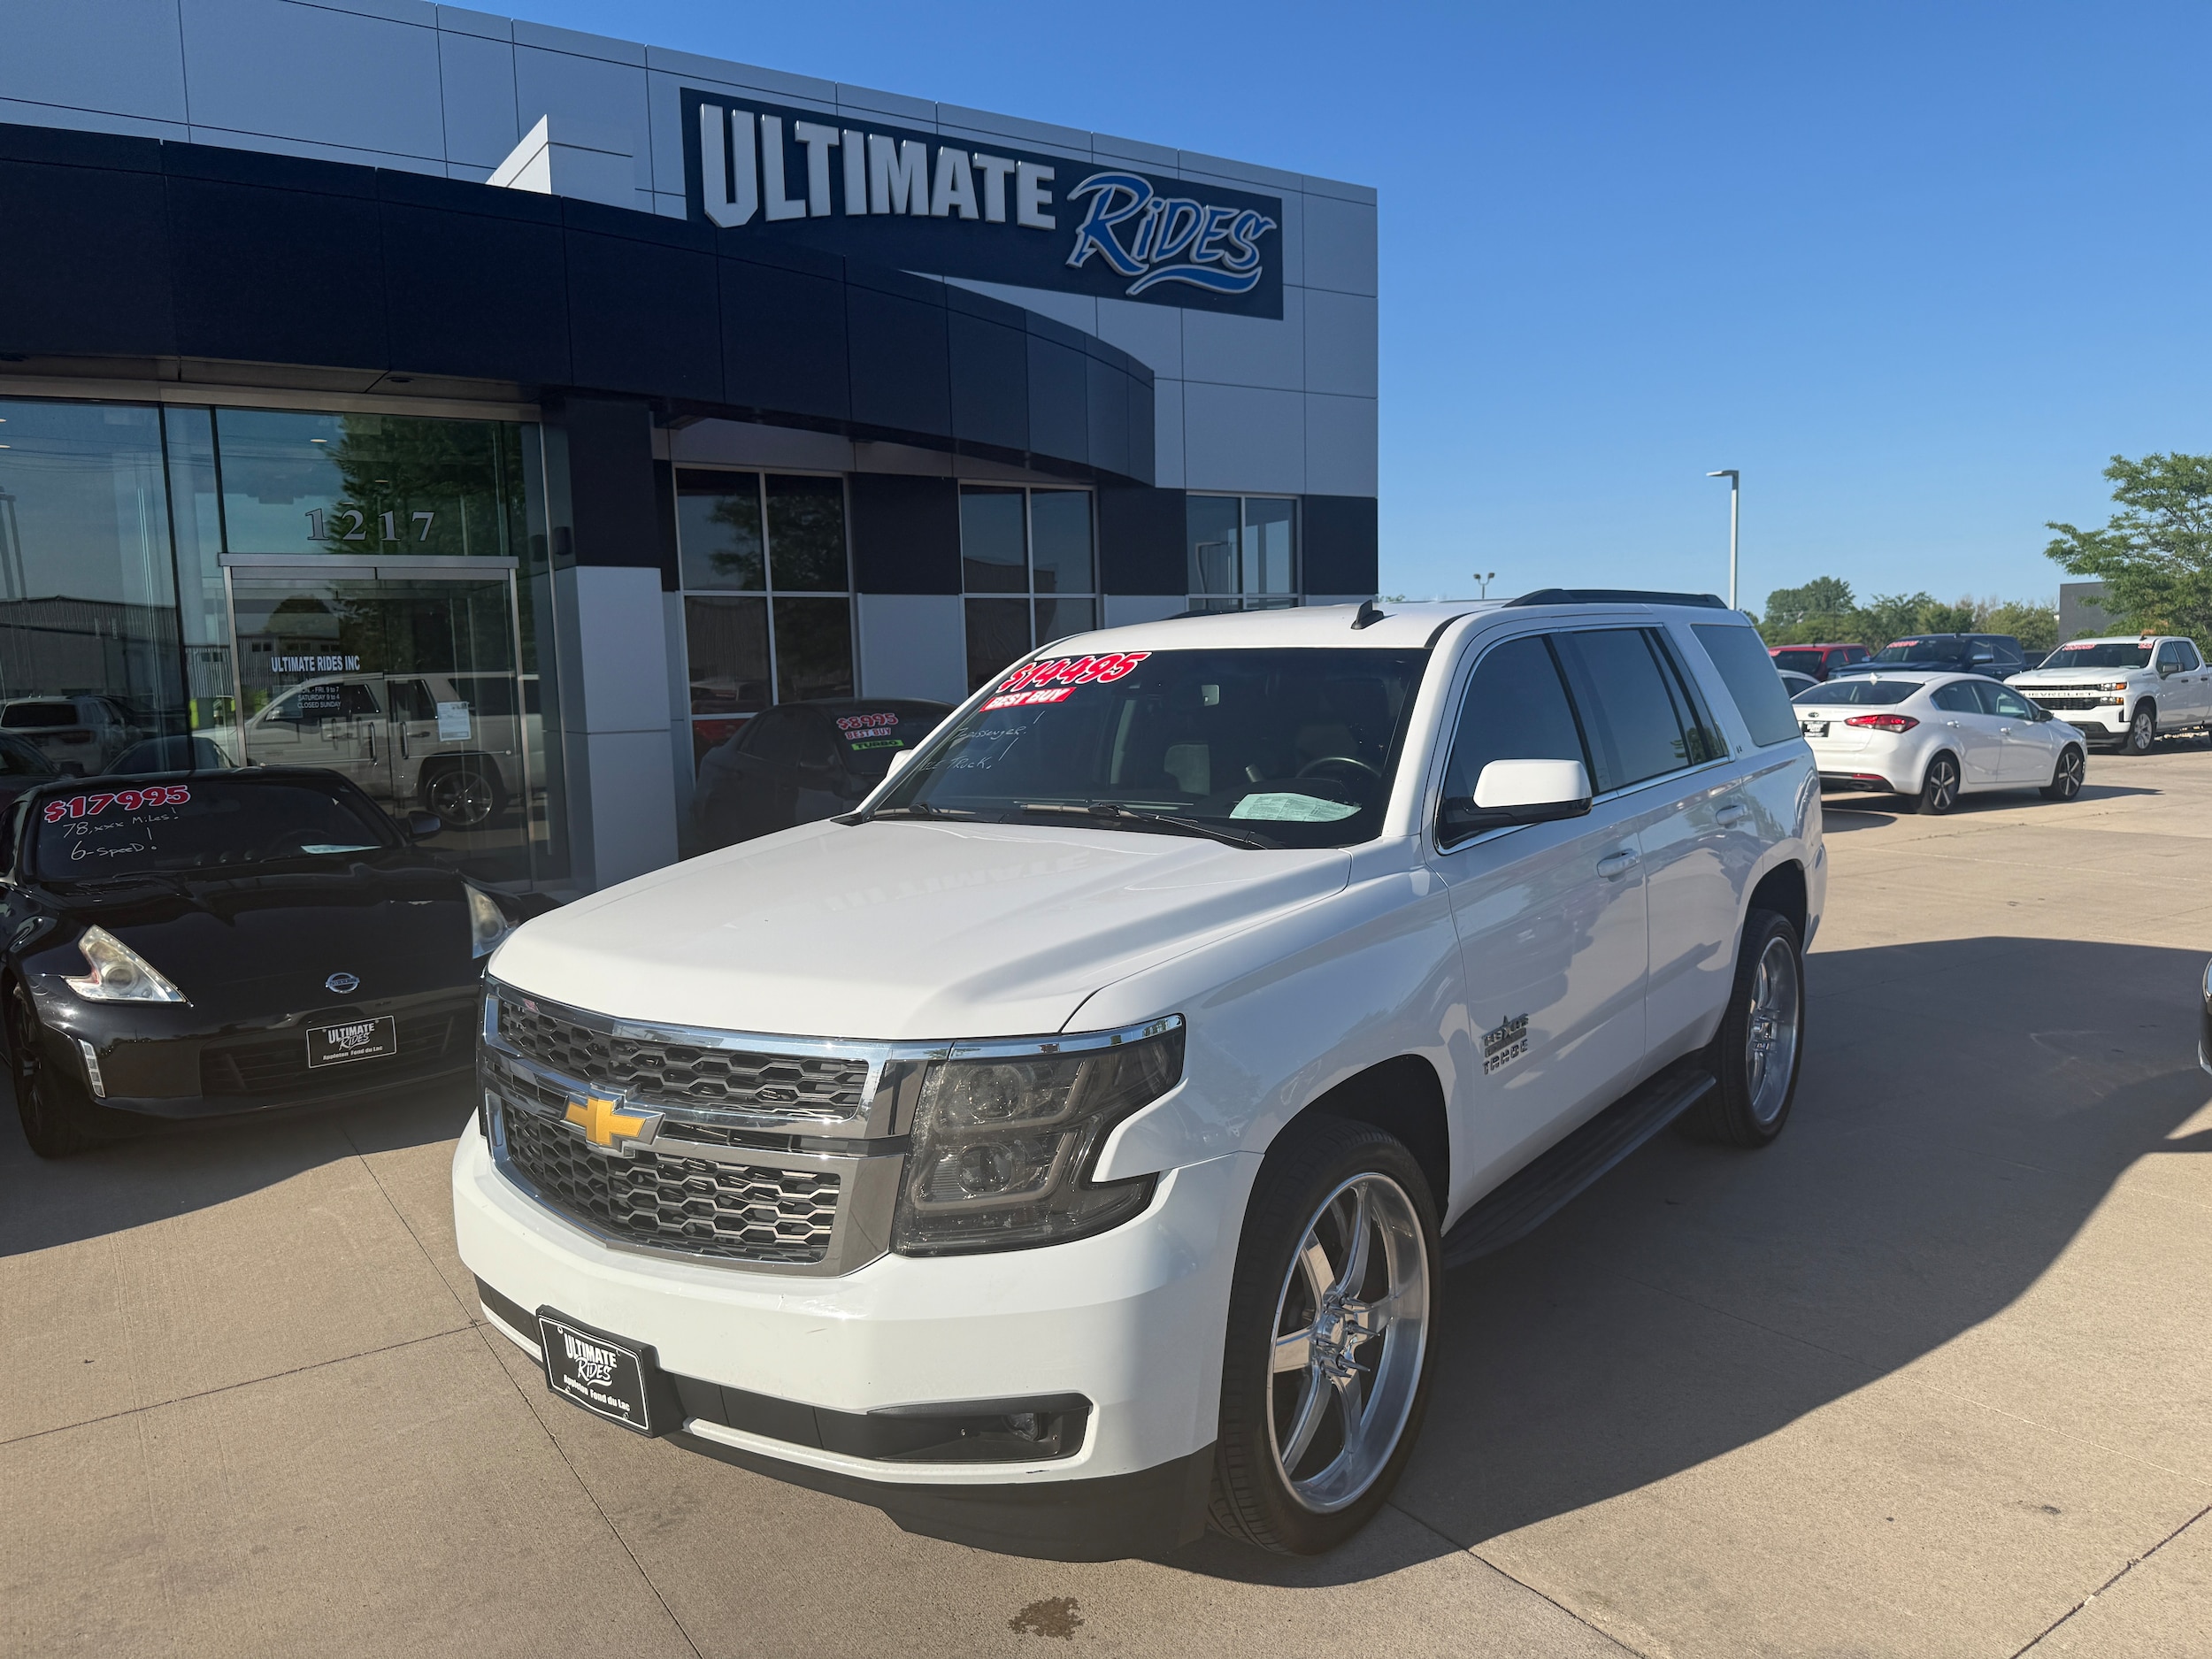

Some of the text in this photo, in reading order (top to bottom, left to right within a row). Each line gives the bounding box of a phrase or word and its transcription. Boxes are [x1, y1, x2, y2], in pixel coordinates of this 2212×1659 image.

[701, 104, 1056, 230] ULTIMATE
[304, 508, 435, 542] 1217
[271, 656, 360, 672] ULTIMATE RIDES INC
[995, 652, 1152, 694] $14495
[988, 687, 1070, 710] BEST BUY
[837, 713, 898, 730] $8995
[847, 727, 891, 740] BEST BUY
[856, 741, 898, 749] TURBO
[44, 785, 191, 823] $17995
[328, 1023, 375, 1044] ULTIMATE
[322, 1051, 349, 1061] Appleton
[350, 1048, 365, 1056] Fond
[1483, 1039, 1528, 1075] TAHOE
[564, 1333, 618, 1369] ULTIMATE
[563, 1374, 631, 1412] Appleton Fond du Lac
